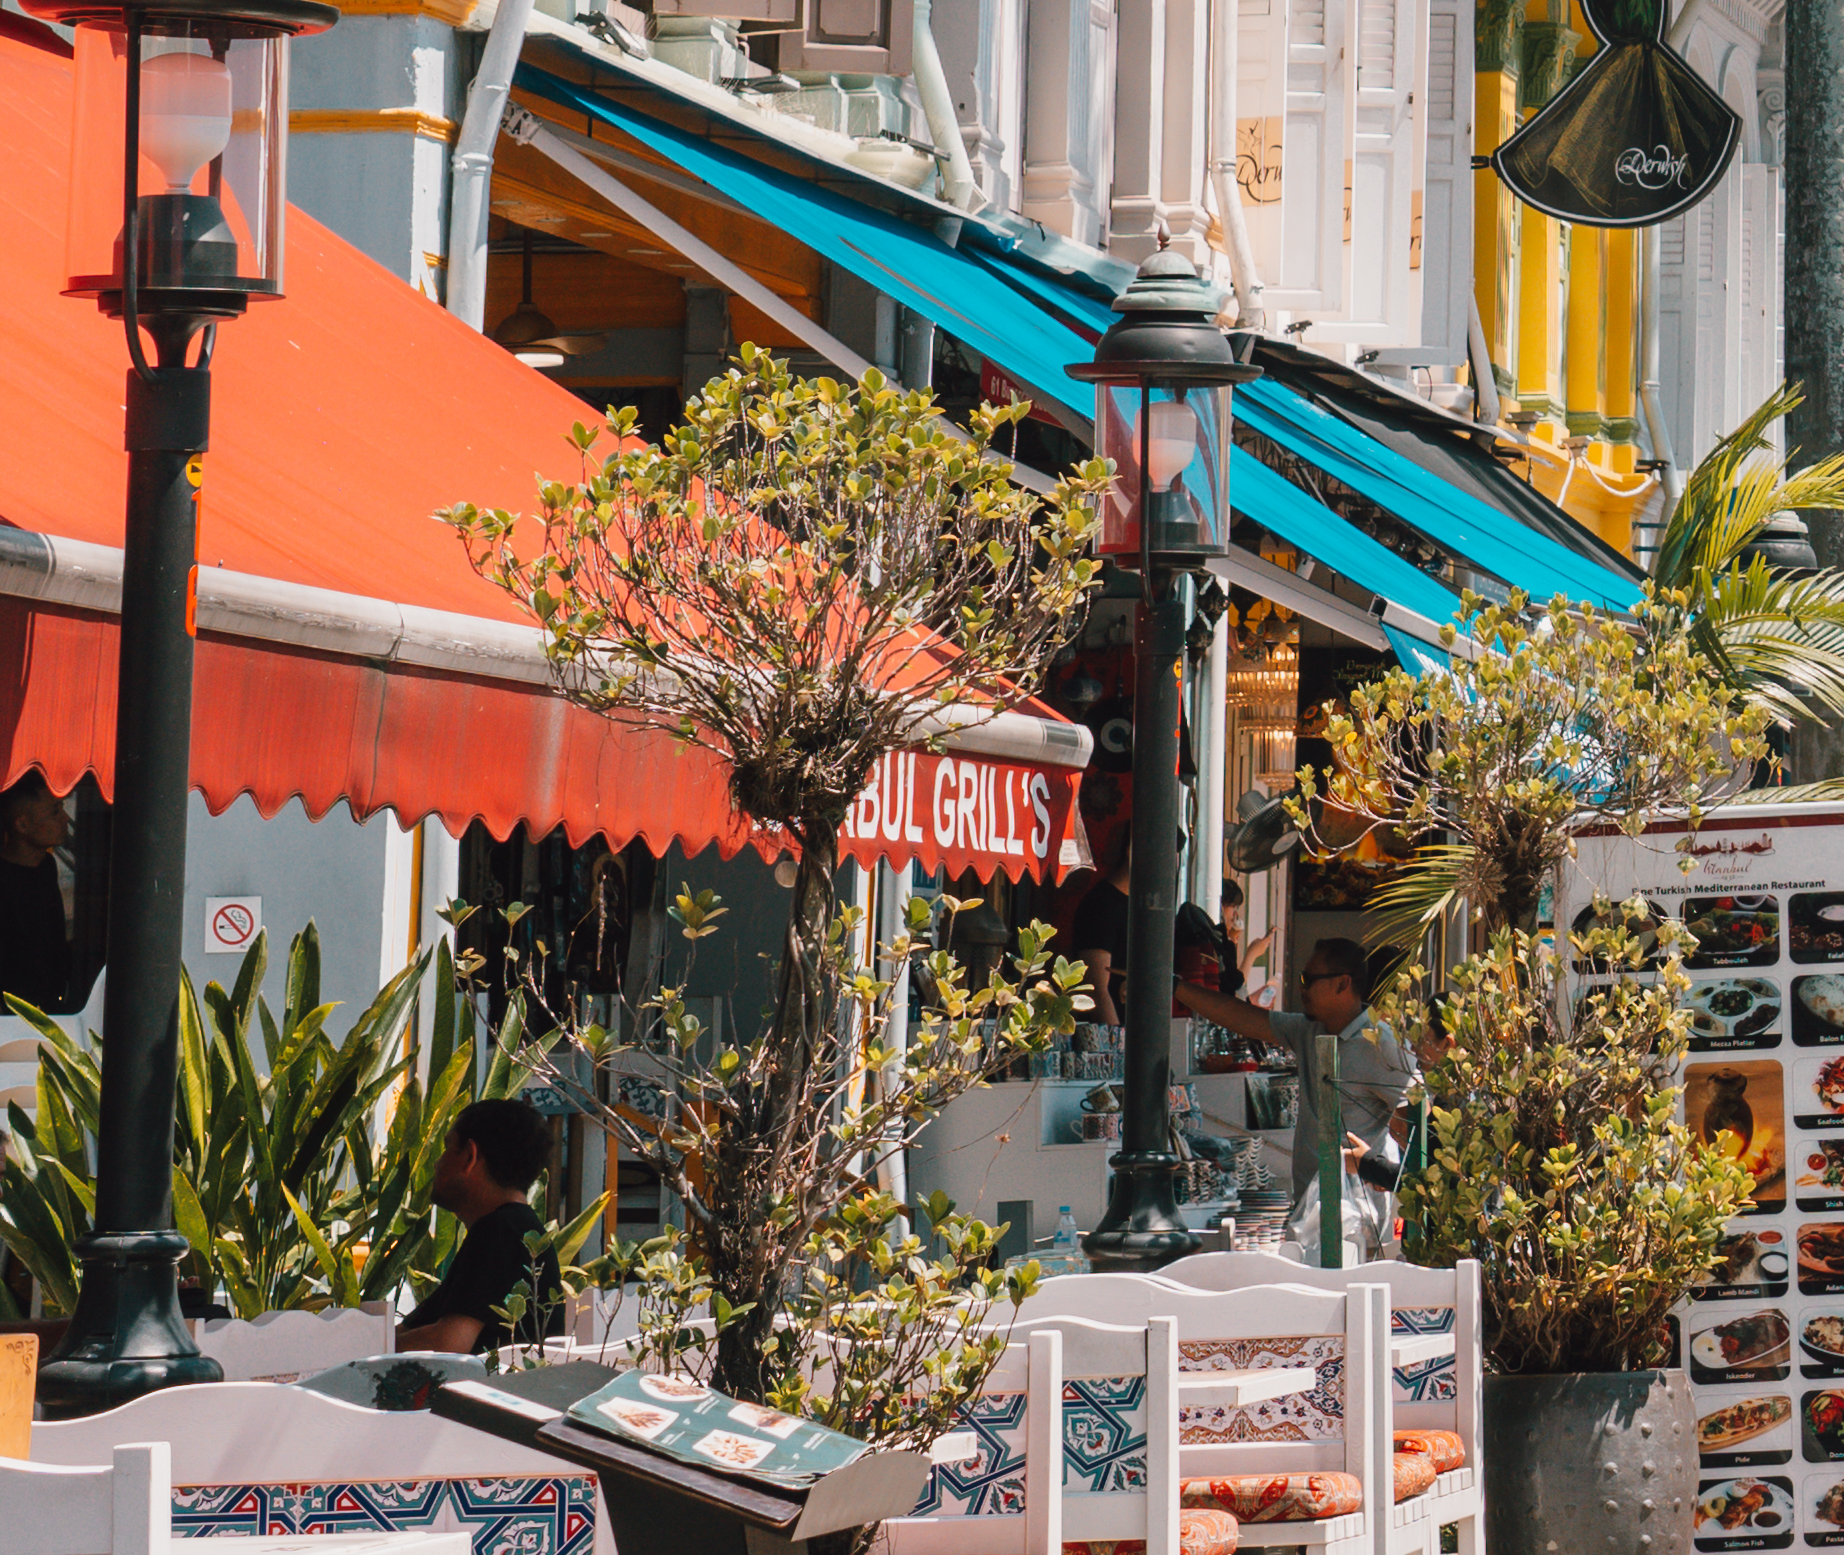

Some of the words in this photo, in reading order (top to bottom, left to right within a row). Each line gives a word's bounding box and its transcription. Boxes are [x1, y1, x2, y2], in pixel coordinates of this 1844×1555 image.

[932, 756, 1051, 858] GRILL'S
[1655, 885, 1692, 895] Turkish
[1694, 883, 1769, 893] Mediterranean
[1771, 879, 1826, 890] Restaurant
[1817, 1118, 1844, 1126] Seafood
